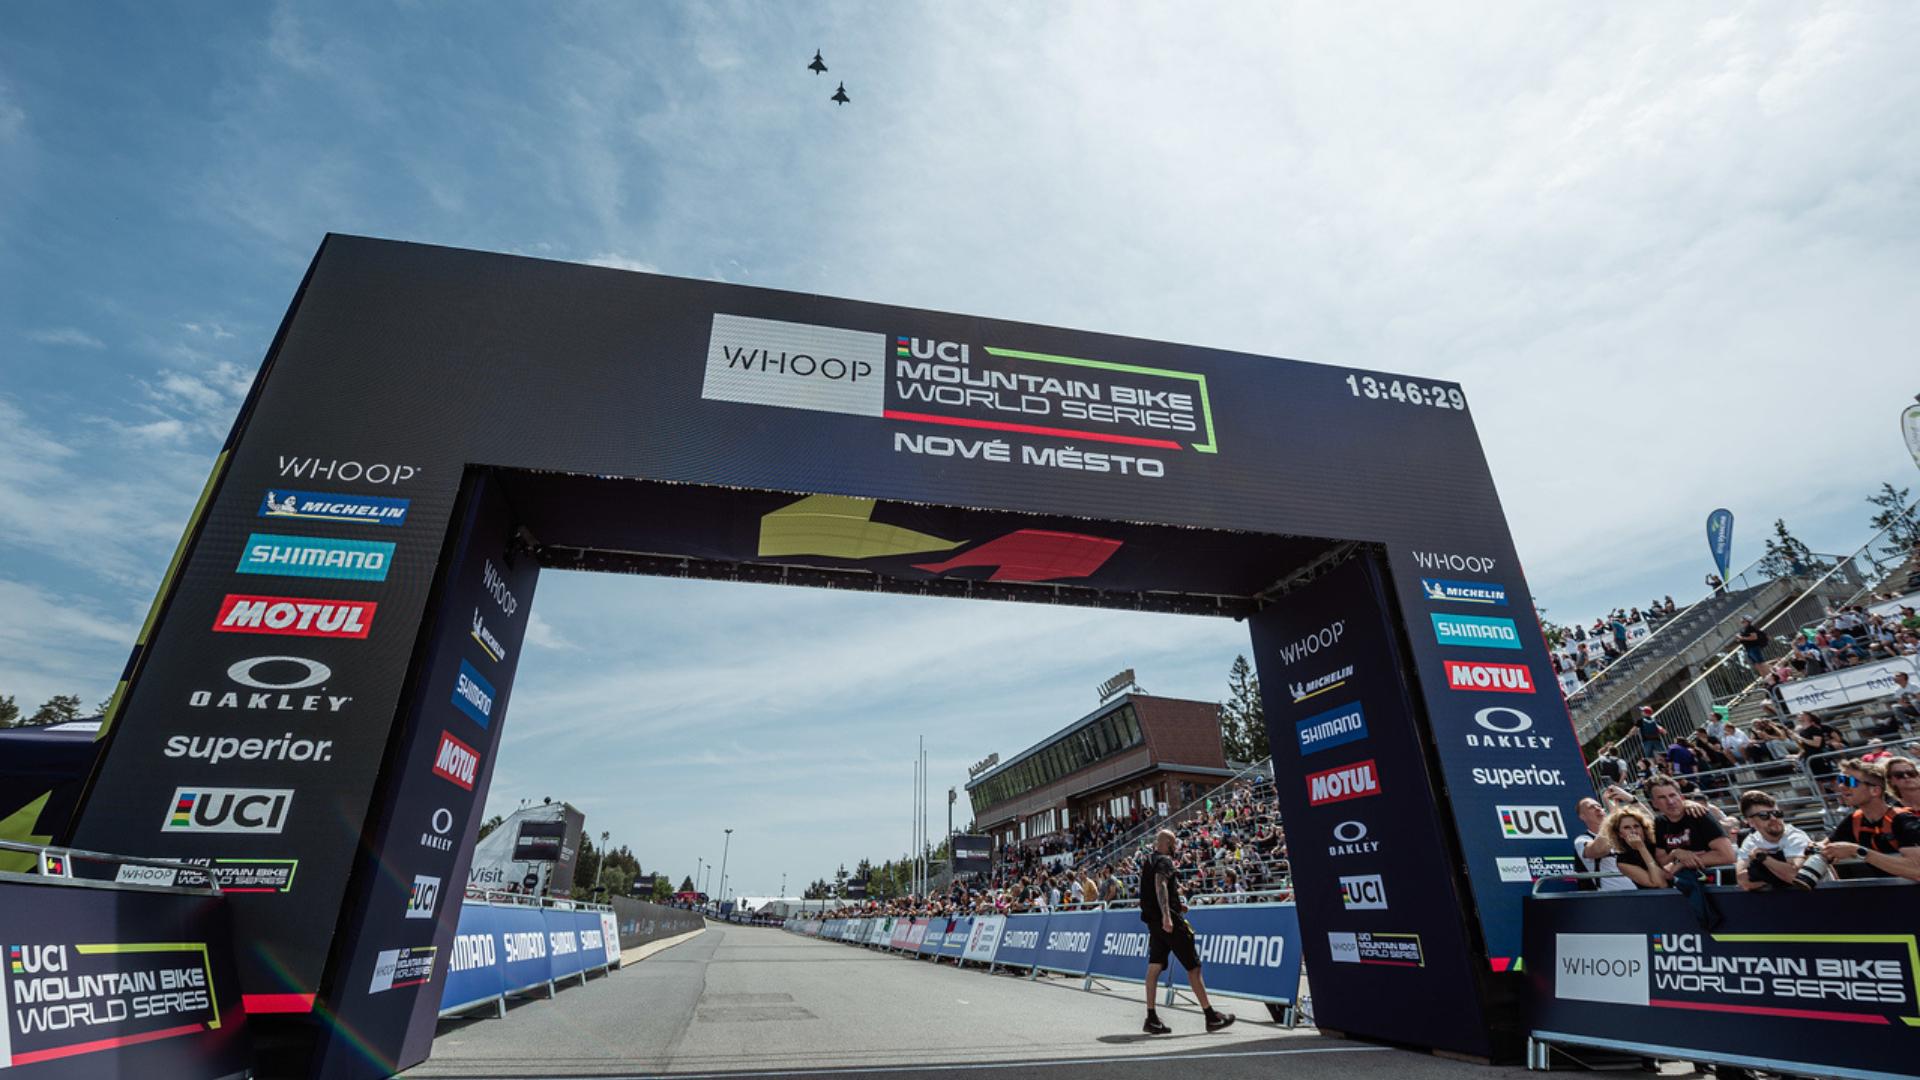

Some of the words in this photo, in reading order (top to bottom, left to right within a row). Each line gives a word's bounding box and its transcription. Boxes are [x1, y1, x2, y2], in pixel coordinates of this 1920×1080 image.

[722, 345, 872, 383] WHOOP
[910, 337, 969, 364] UCI
[896, 360, 1100, 400] MOUNTAIN
[1110, 385, 1193, 412] BIKE
[1345, 374, 1465, 410] 13:46:29
[896, 380, 1050, 415] WORLD
[1061, 400, 1196, 432] SERIES
[894, 432, 1011, 463] NOVÉ
[1022, 446, 1164, 478] MĚSTO
[278, 455, 416, 485] WHOOP
[301, 501, 405, 518] MICHELIN
[249, 545, 384, 570] SHIMANO
[1412, 551, 1495, 574] WHOOP
[482, 559, 518, 617] WHOOP
[1446, 587, 1505, 599] MICHELIN
[222, 600, 364, 633] MOTUL
[481, 625, 506, 661] MICHELIN
[1280, 620, 1344, 665] WHOOP
[1438, 622, 1515, 640] SHIMANO
[1306, 665, 1354, 692] MICHELIN
[1452, 665, 1530, 689] MOTUL
[189, 690, 347, 712] OAKLEY
[457, 672, 492, 716] SHIMANO
[1300, 712, 1362, 745] SHIMANO
[1466, 734, 1552, 749] OAKLEY
[163, 732, 333, 764] superior.
[436, 738, 477, 785] MOTUL
[1311, 766, 1376, 801] MOTUL
[1472, 764, 1566, 789] superior.
[194, 793, 286, 828] UCI
[1512, 810, 1563, 835] UCI
[421, 833, 453, 852] OAKLEY
[1329, 841, 1379, 856] OAKLEY
[122, 869, 174, 880] WHOOP
[470, 867, 504, 883] Visit
[413, 884, 438, 911] UCI
[1348, 880, 1383, 903] UCI
[449, 934, 496, 972] IMANO
[504, 932, 546, 962] SHIMANO
[550, 931, 577, 956] SHIMANO
[1003, 930, 1039, 949] SHIMANO
[1046, 931, 1091, 952] SHIMANO
[1102, 932, 1150, 957] SHIMA
[1661, 934, 1702, 953] UCI
[22, 945, 68, 972] UCI
[1562, 957, 1641, 978] WHOOP
[1654, 955, 1807, 977] MOUNTAIN
[1817, 958, 1903, 980] BIKE
[14, 970, 155, 1004] MOUNTAIN
[160, 968, 205, 989] BIKE
[1655, 974, 1763, 995] WORLD
[1772, 978, 1905, 1003] SERIES
[17, 999, 127, 1034] WORLD
[133, 990, 209, 1019] SERIES
